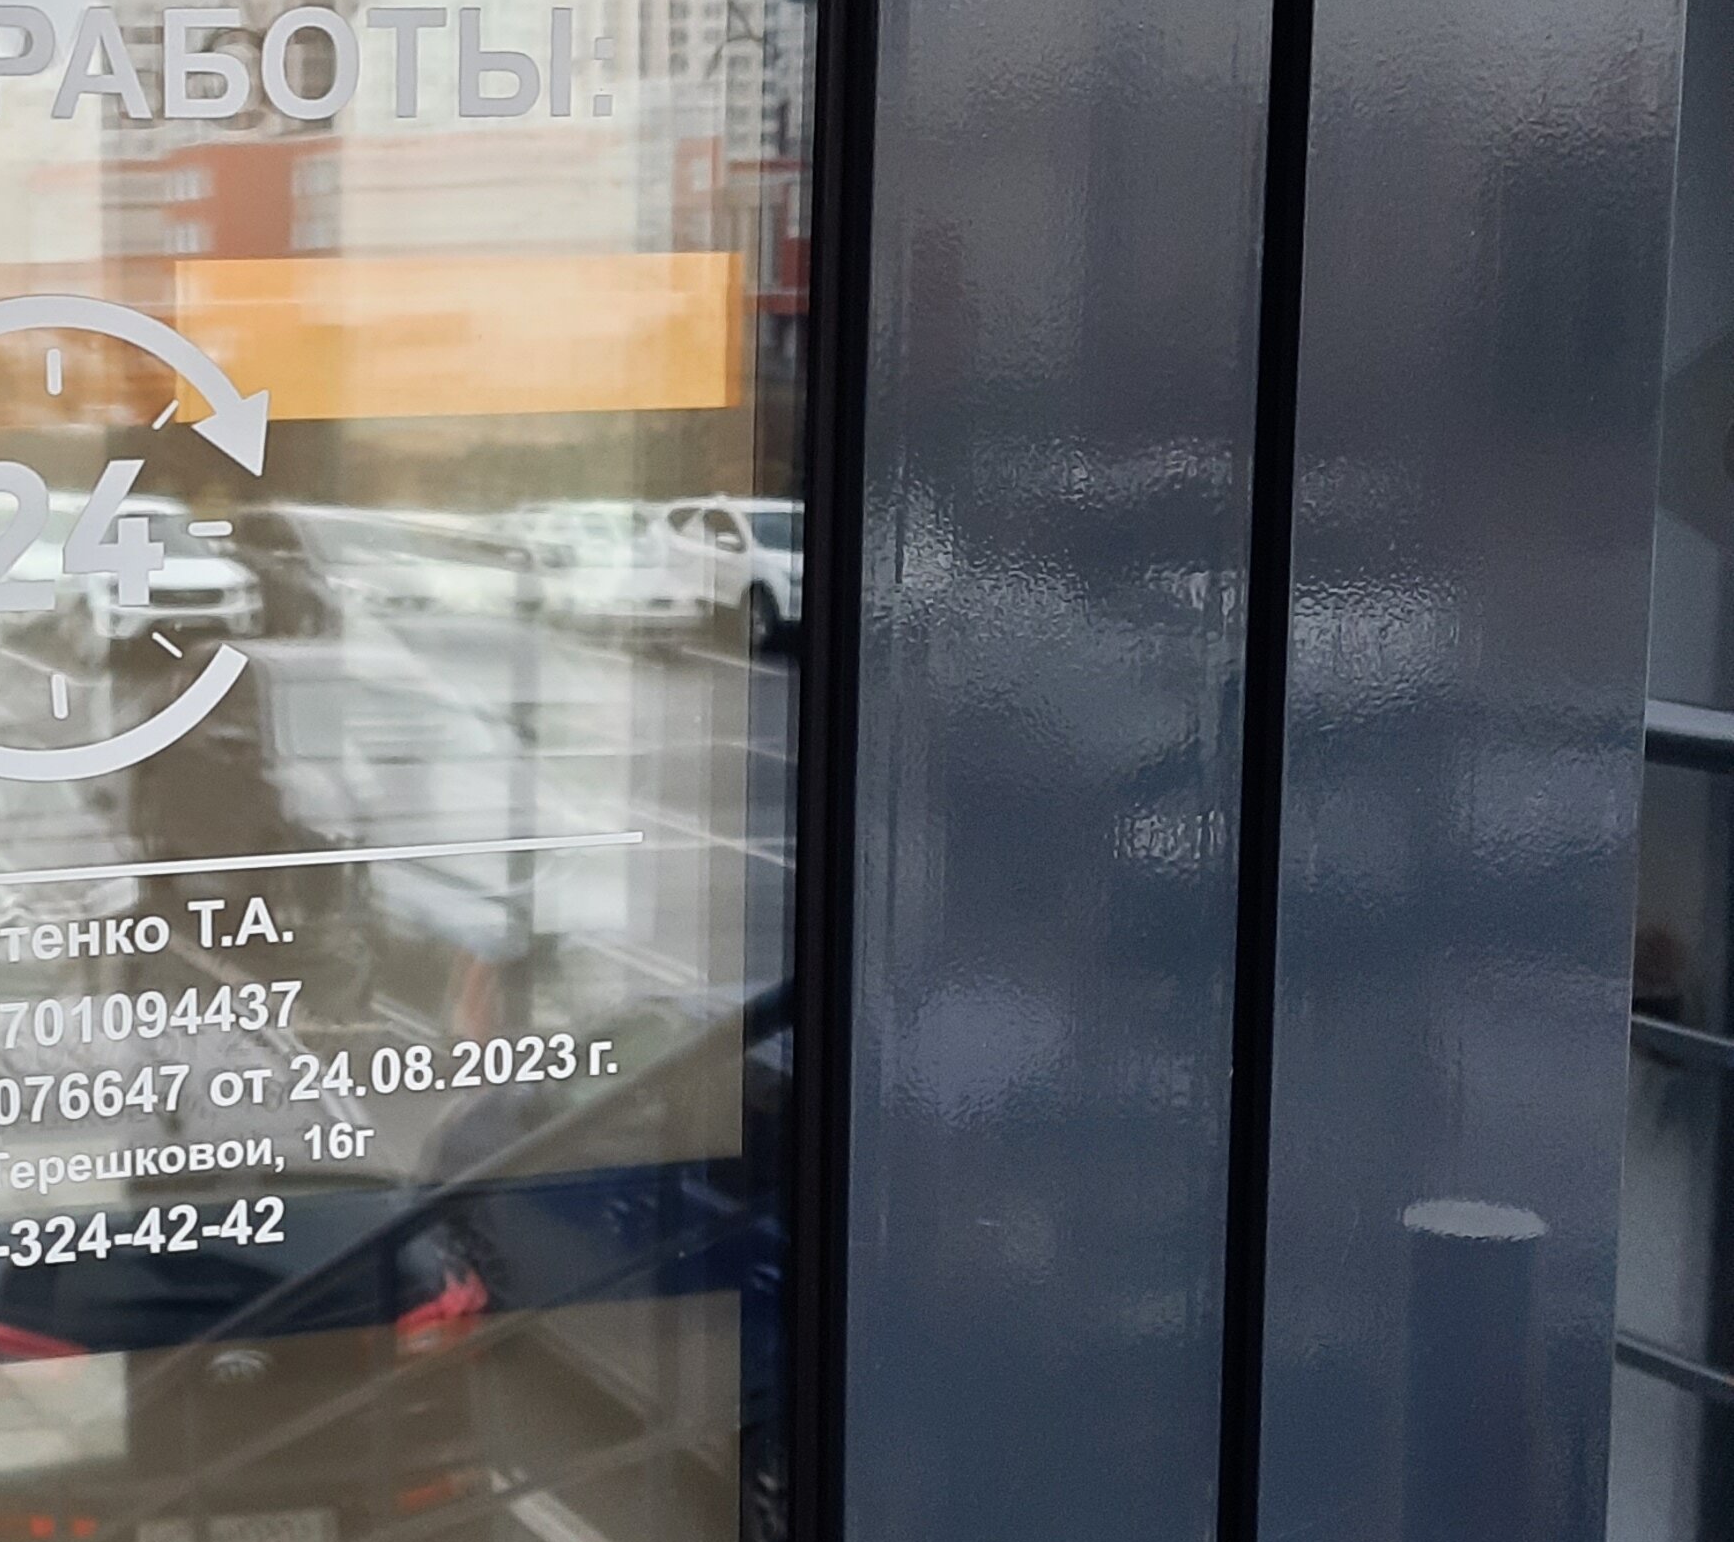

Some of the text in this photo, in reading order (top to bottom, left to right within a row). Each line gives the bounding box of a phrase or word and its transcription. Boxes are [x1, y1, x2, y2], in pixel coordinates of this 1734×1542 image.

[188, 897, 294, 948] Т.А.
[210, 1069, 273, 1106] от
[289, 1033, 575, 1101] 24.08.2023
[303, 1123, 375, 1160] 16г
